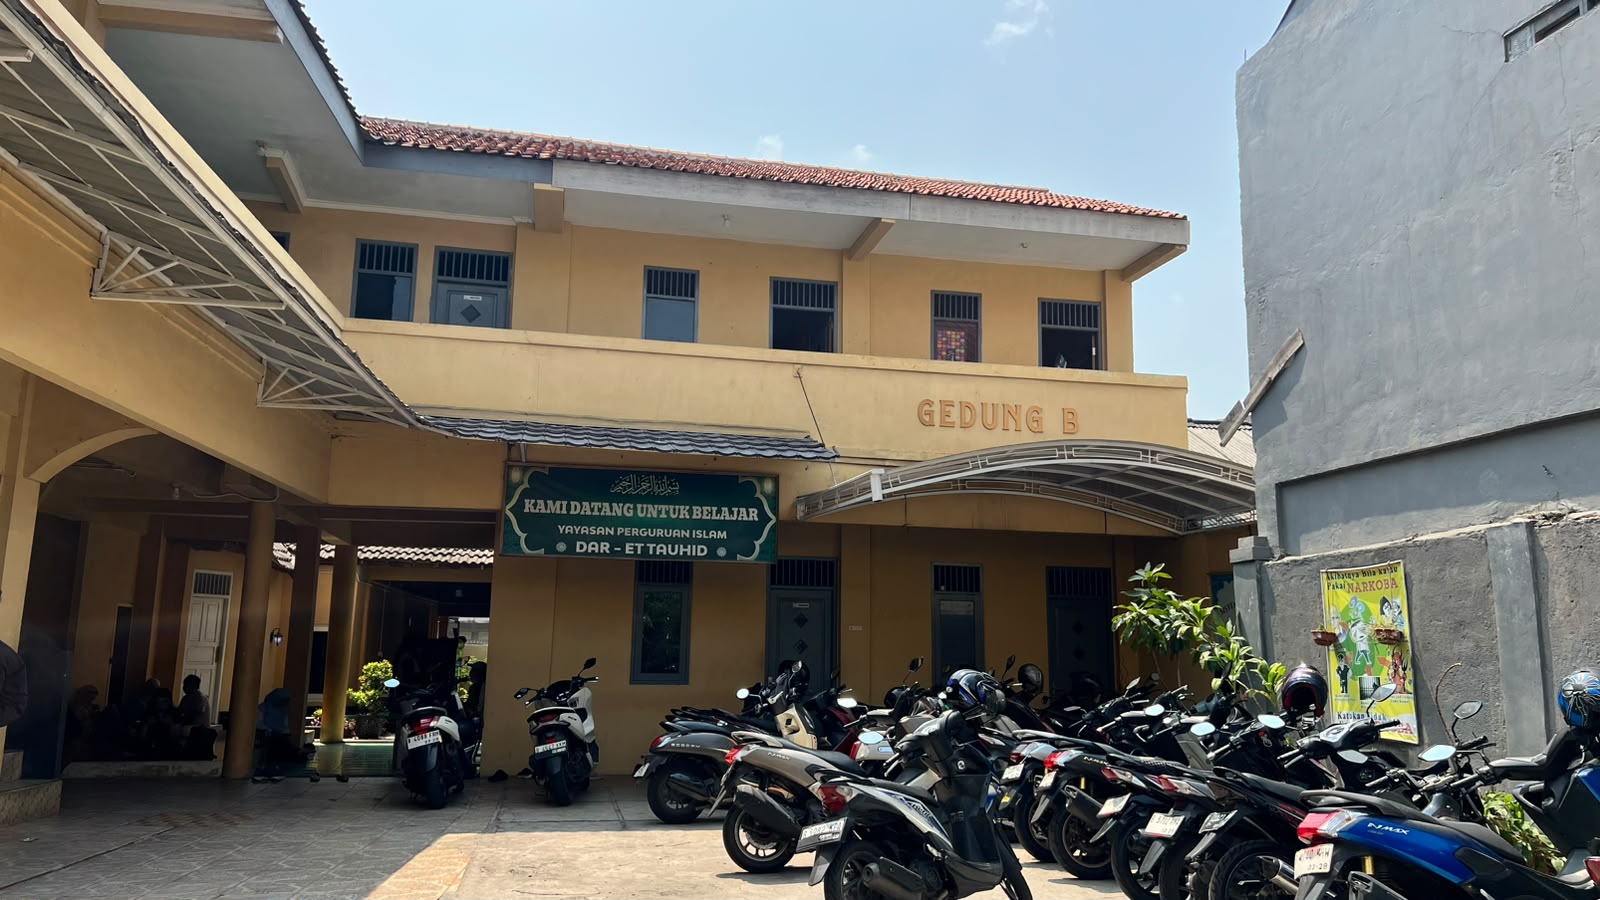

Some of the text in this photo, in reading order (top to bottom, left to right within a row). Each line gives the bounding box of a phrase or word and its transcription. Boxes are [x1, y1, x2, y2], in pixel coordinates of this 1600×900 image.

[917, 399, 1079, 434] GEDUNG B
[524, 499, 759, 522] KAMI DATANG UNTUK BELAJAR
[558, 524, 727, 539] YAYASAN PERGURUAN ISLAM
[575, 541, 610, 554] DAR
[625, 543, 645, 555] ET
[646, 543, 708, 557] TAUHID
[1328, 577, 1398, 593] Pakai NARKOBA
[1367, 822, 1410, 835] NMAX
